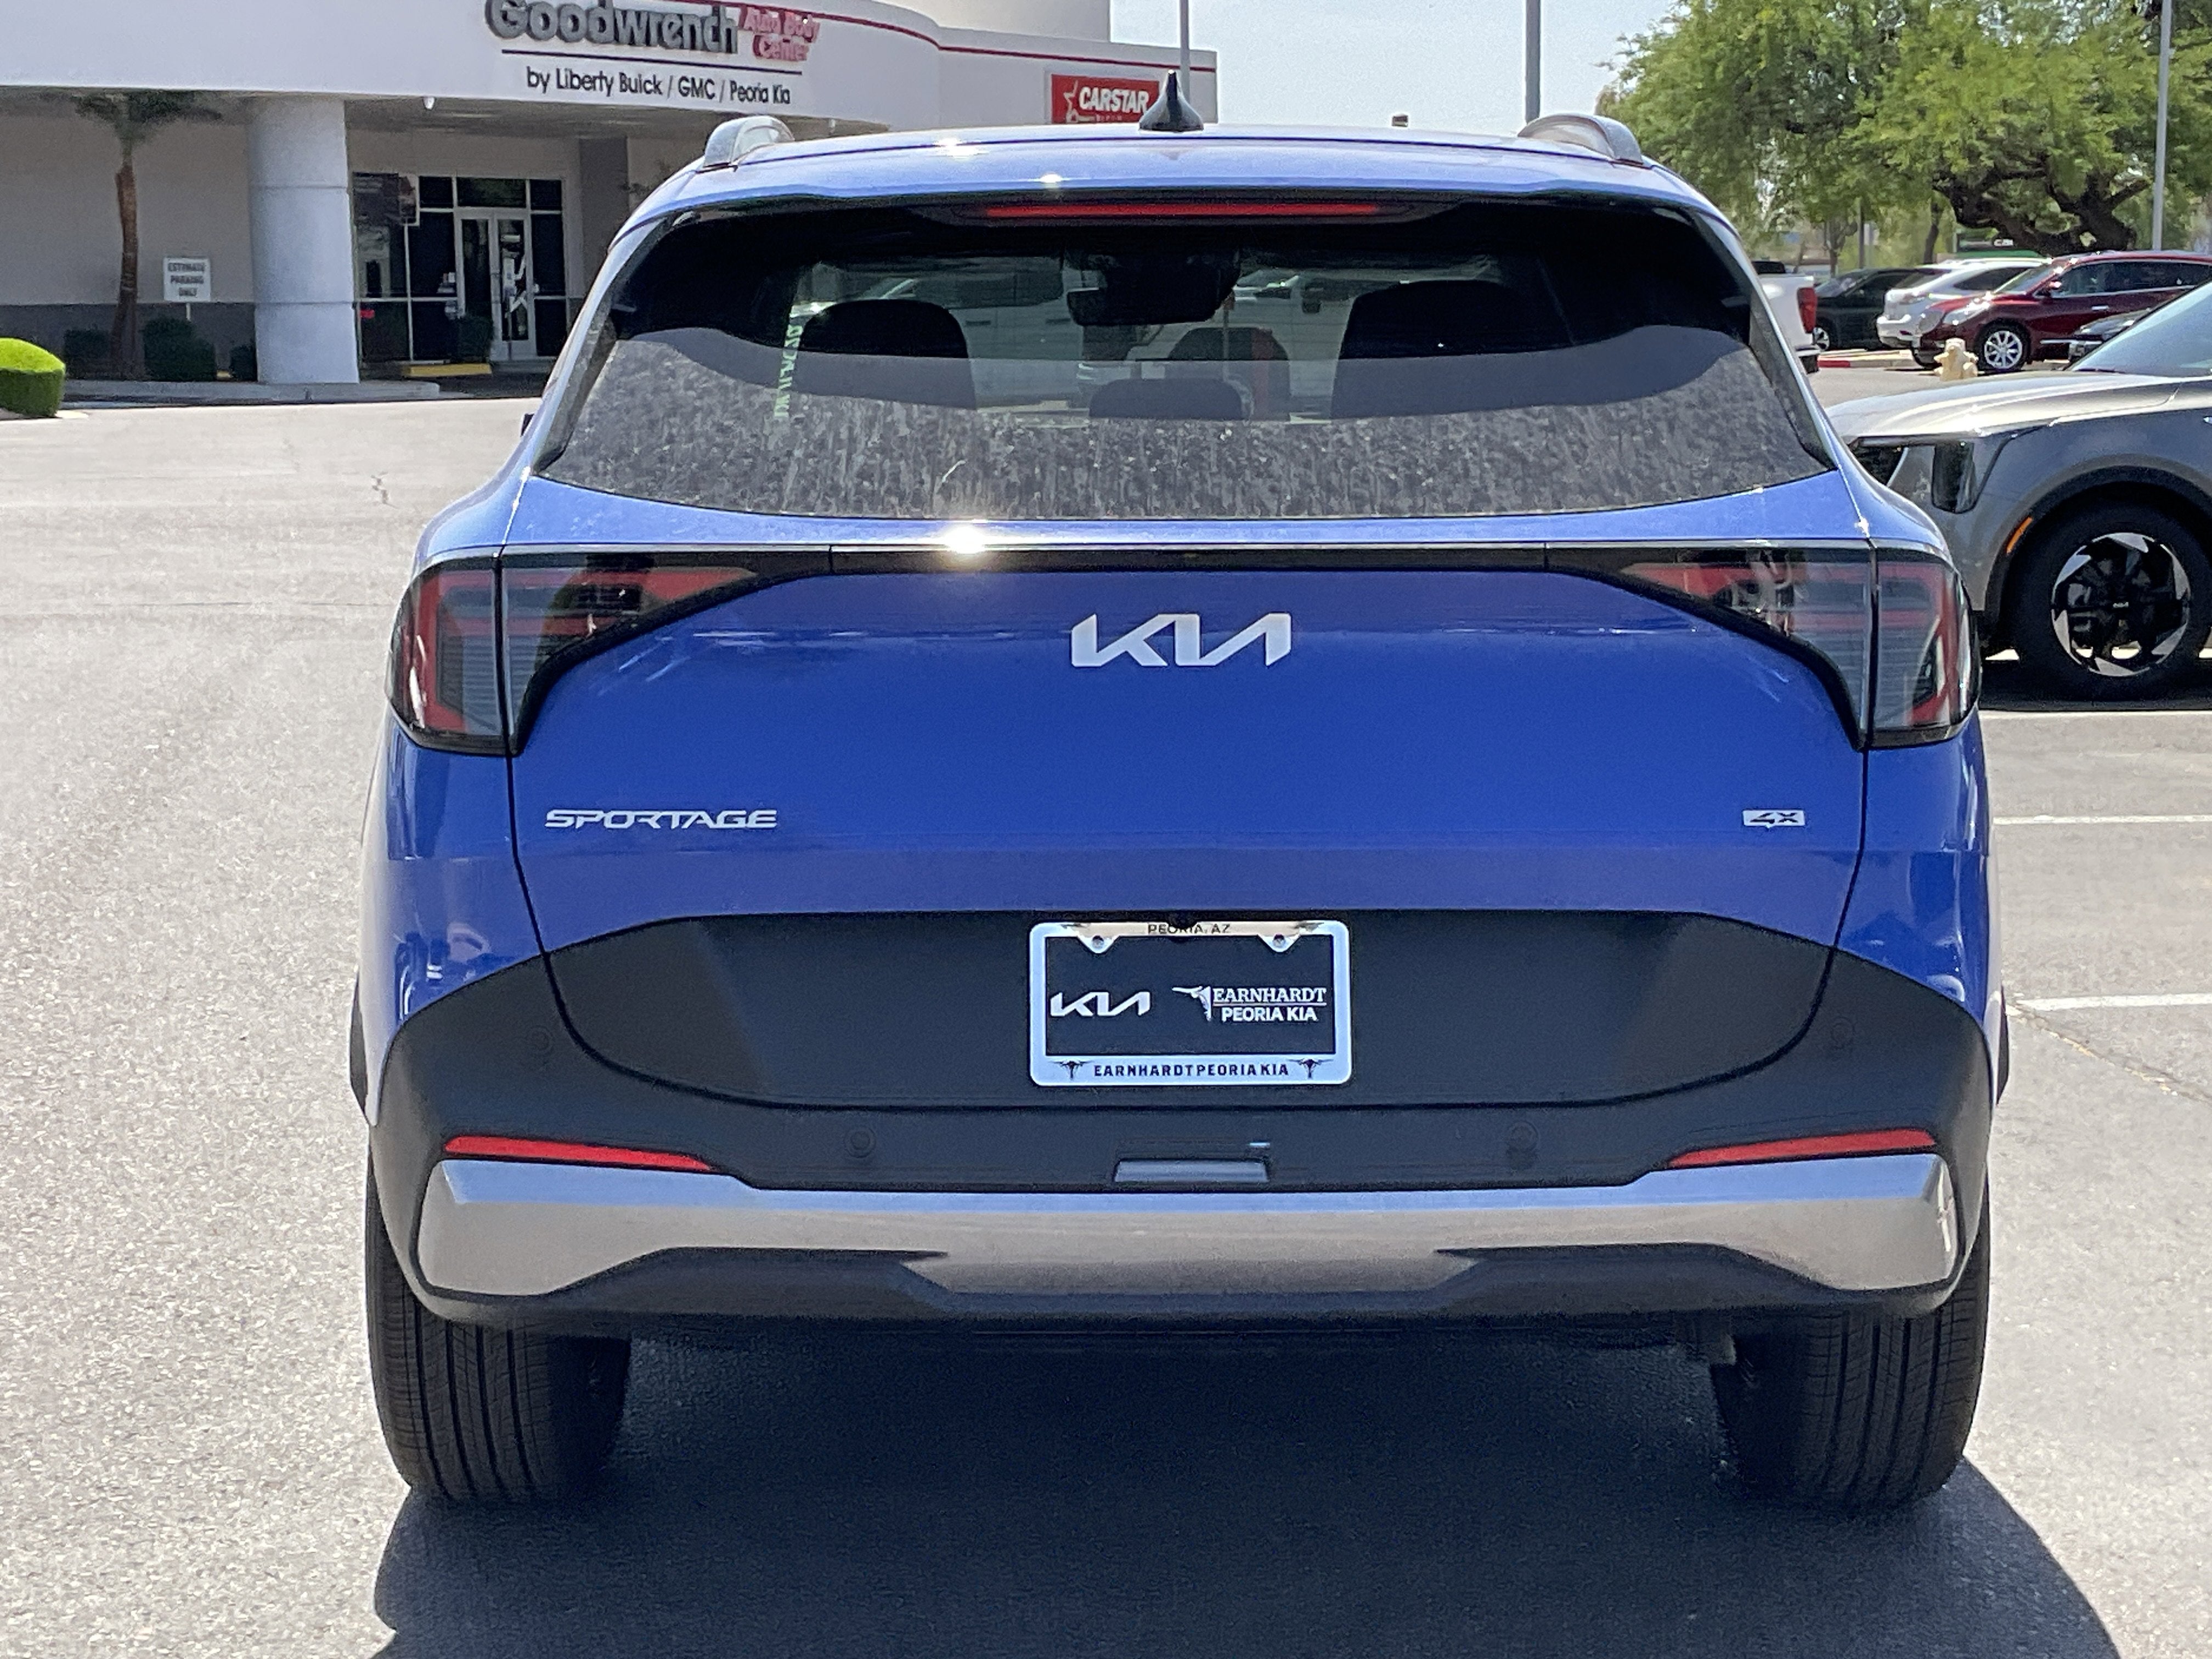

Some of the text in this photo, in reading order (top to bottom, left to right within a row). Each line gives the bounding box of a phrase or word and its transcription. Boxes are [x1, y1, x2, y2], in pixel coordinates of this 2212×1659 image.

[485, 0, 738, 53] Goodwrench
[526, 66, 791, 104] by Liberty Buick / GMC / Peoria Kia
[1079, 86, 1149, 114] CARSTAR
[1071, 613, 1291, 667] KIA
[545, 809, 777, 829] SPORTAGE
[1211, 923, 1231, 934] AZ
[1050, 991, 1151, 1017] KIA
[1212, 988, 1327, 1003] EARNHARDT
[1221, 1006, 1318, 1022] PEORIA KIA
